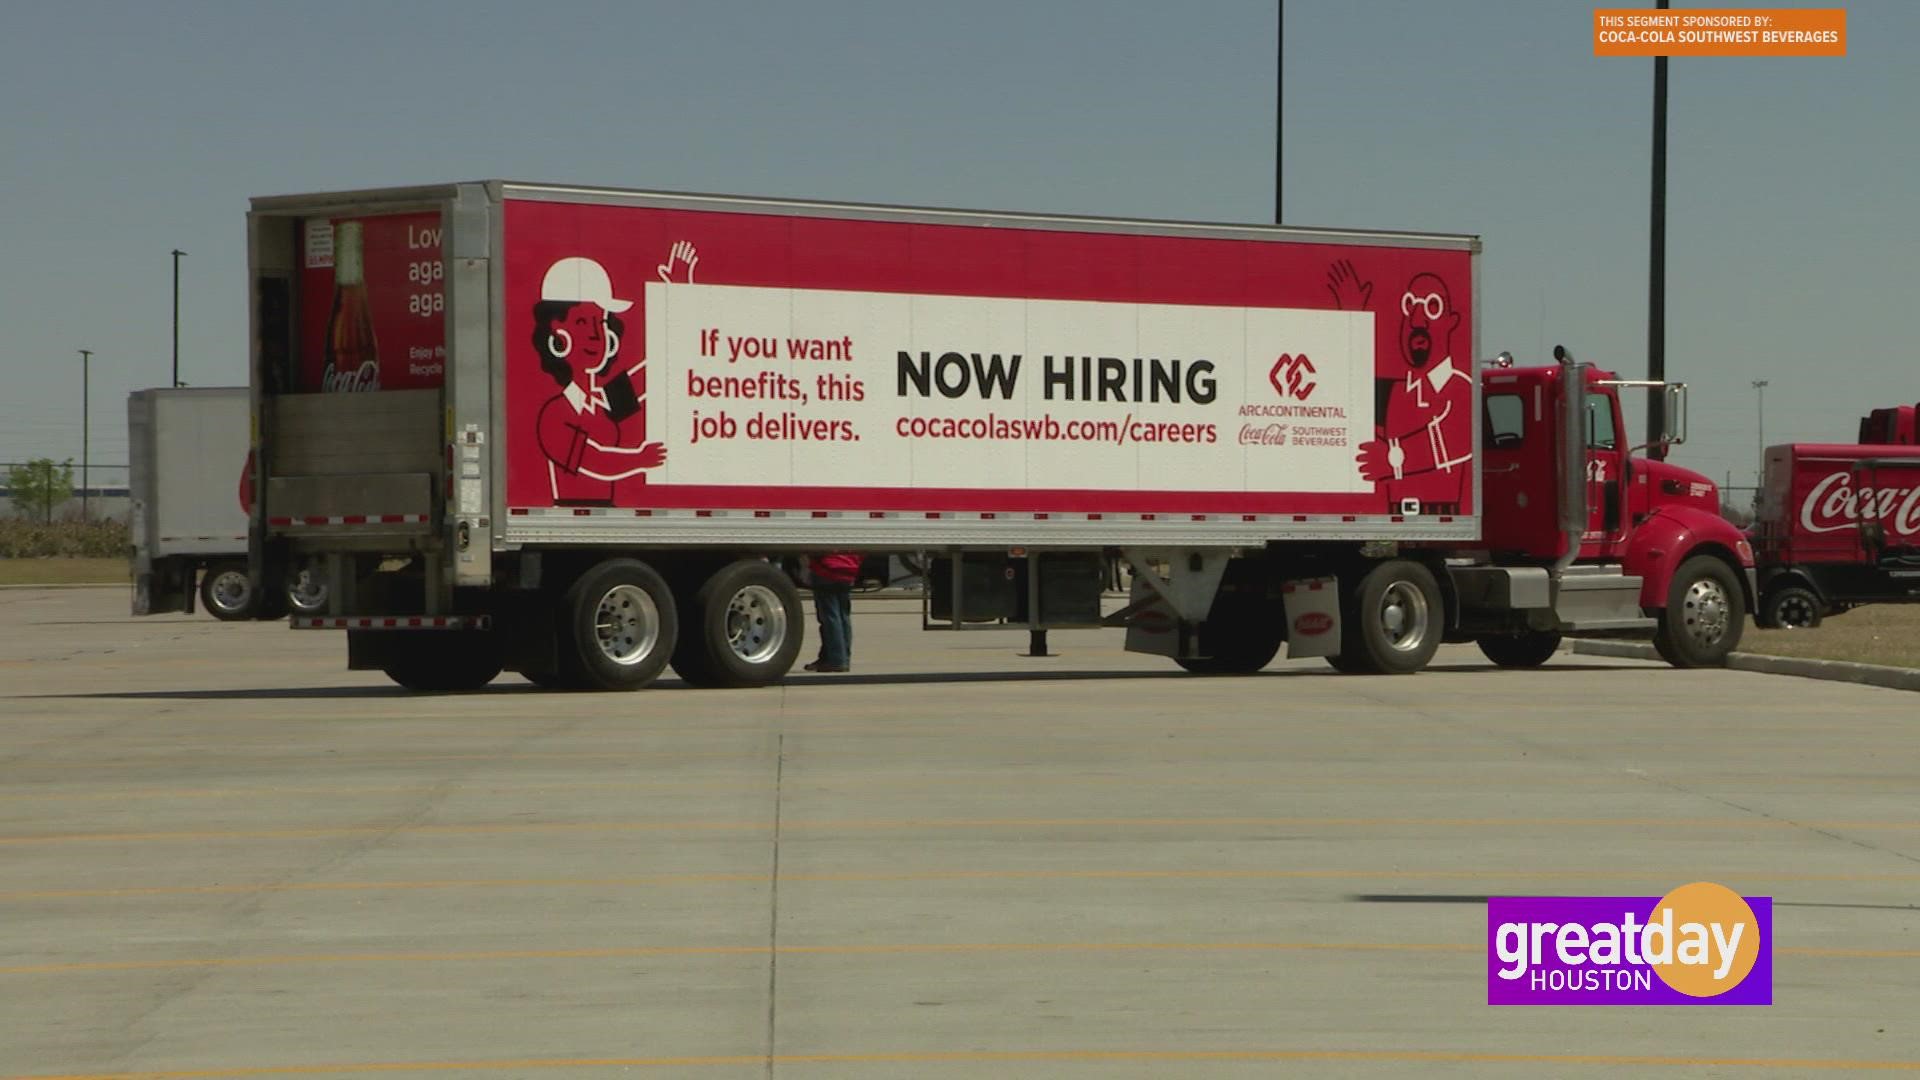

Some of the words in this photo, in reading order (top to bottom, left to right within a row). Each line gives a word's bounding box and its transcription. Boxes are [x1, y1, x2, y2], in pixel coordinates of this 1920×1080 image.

[701, 329, 719, 357] If
[728, 336, 777, 363] you
[787, 336, 853, 361] want
[688, 369, 808, 405] benefits,
[817, 374, 865, 401] this
[897, 351, 1022, 399] NOW
[1044, 356, 1217, 405] HIRING
[691, 411, 737, 443] job
[746, 412, 860, 441] delivers.
[1238, 405, 1347, 418] ARCACONTINENTAL
[896, 413, 1217, 445] cocacolaswb.com/careers
[1292, 426, 1347, 437] SOUTHWEST
[1292, 436, 1347, 447] BEVERAGES
[1800, 471, 1920, 535] Coca-C
